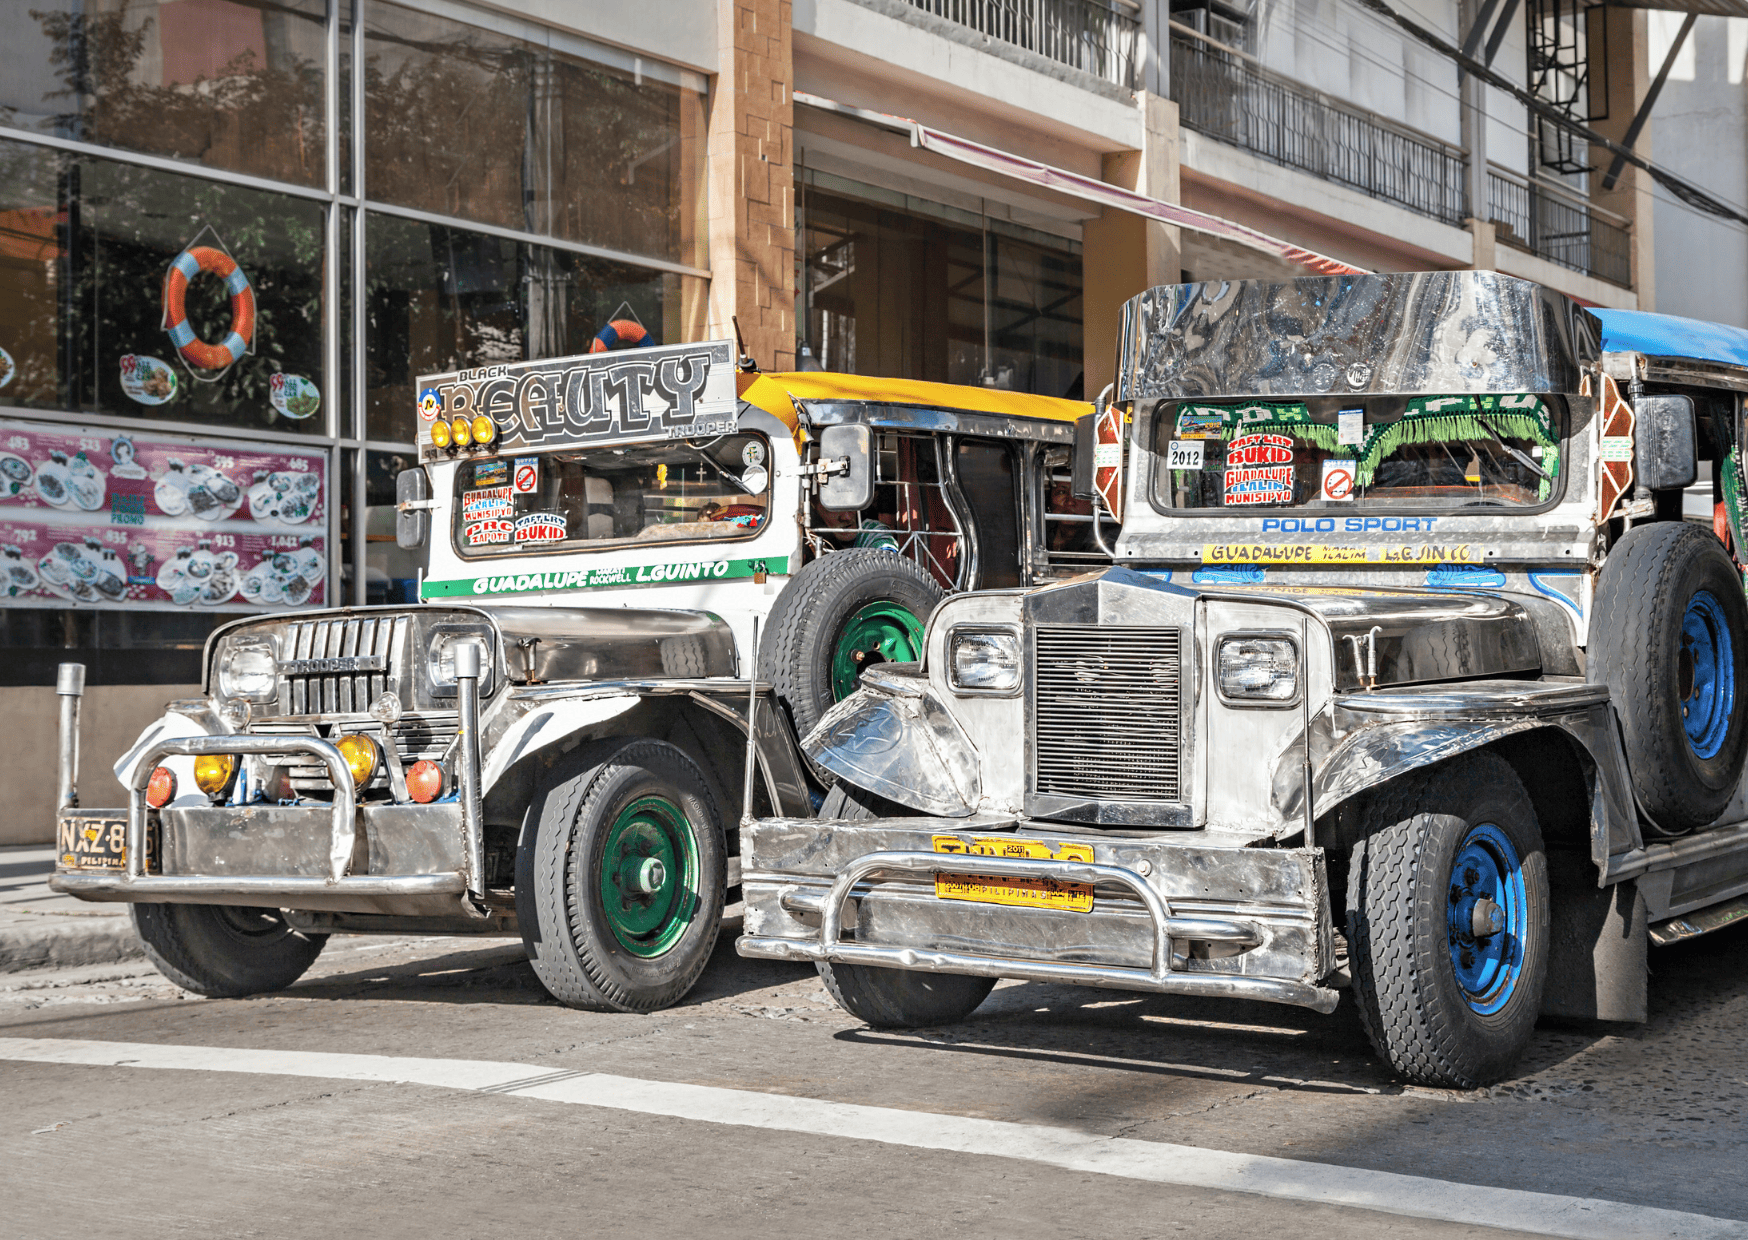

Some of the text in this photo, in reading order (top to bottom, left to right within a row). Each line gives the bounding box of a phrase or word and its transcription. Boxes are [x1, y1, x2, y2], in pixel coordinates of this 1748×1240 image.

[459, 366, 508, 382] BLACK
[438, 350, 712, 444] BEAUTY
[666, 420, 738, 438] TROOPER
[1229, 434, 1292, 450] TAFT LRT
[1171, 451, 1199, 466] 2012
[1228, 446, 1292, 465] BUKID
[1226, 468, 1293, 489] GUADALUPE
[464, 487, 513, 508] GUADALUPE
[1226, 491, 1291, 504] MUNISIPYO
[465, 507, 512, 521] MUNISIPYO
[466, 521, 513, 537] PRC
[516, 525, 564, 540] BUKID
[1262, 518, 1437, 533] POLO SPORT
[215, 534, 235, 547] 913
[472, 532, 507, 544] ZAPOTE
[1211, 545, 1313, 561] GUADALUPE
[1322, 552, 1367, 560] ILALIM
[636, 560, 729, 582] L.GUINTO
[473, 570, 589, 594] GUADALUPE
[589, 573, 632, 585] ROCKWELL
[290, 659, 360, 674] TROOPER
[1007, 845, 1024, 853] 2011
[80, 856, 124, 866] PILIPIN
[982, 885, 1047, 899] PILIPINAS
